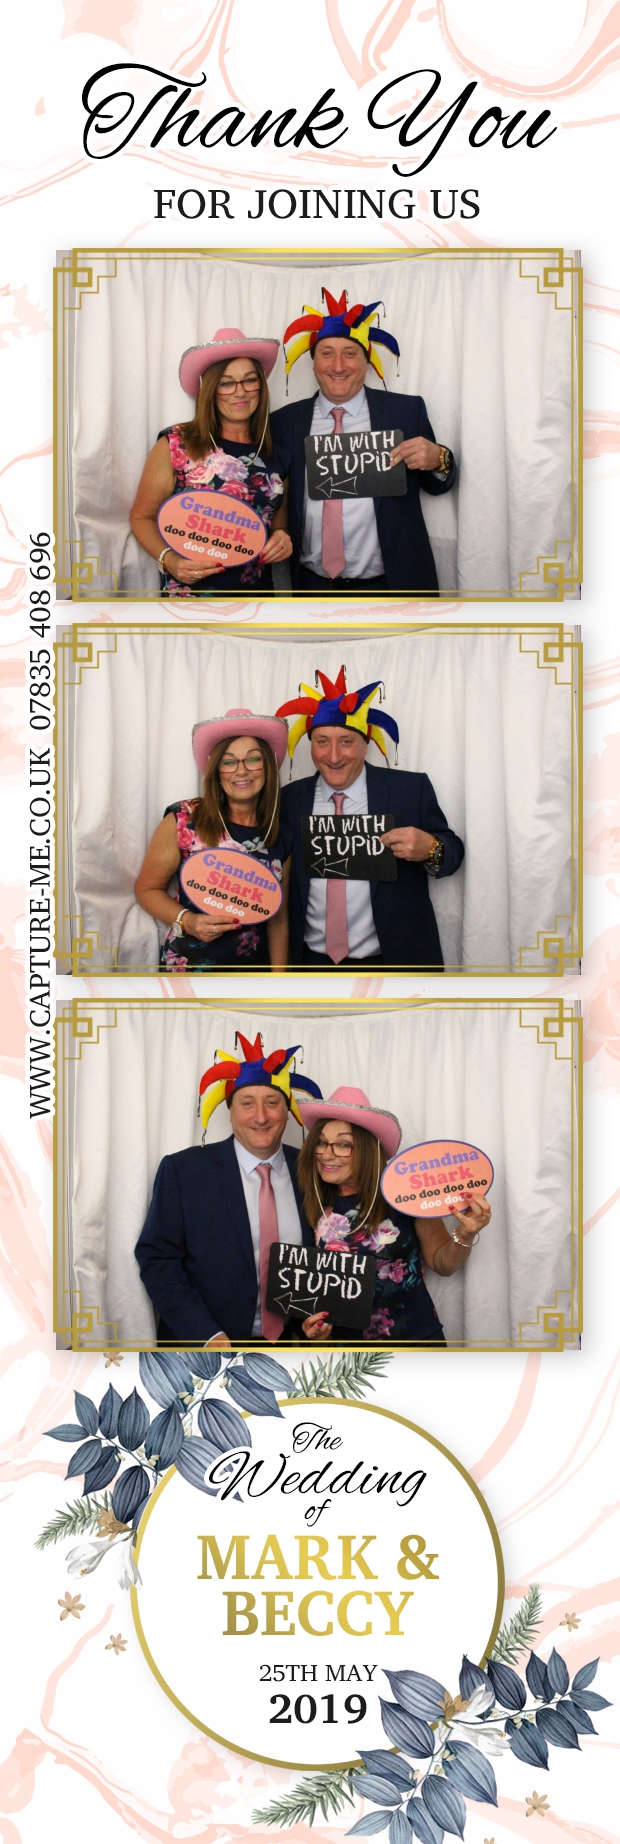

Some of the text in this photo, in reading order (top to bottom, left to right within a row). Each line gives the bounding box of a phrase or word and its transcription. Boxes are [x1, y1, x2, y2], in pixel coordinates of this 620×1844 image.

[314, 434, 343, 454] I'M
[180, 496, 260, 531] Grandma
[164, 525, 254, 556] doo doo doo doo
[185, 514, 247, 543] Shark
[183, 541, 228, 559] doo doo
[309, 816, 336, 834] I'M
[203, 853, 278, 892] Grandma
[186, 879, 270, 916] doo doo doo doo
[206, 870, 264, 904] Shark
[203, 896, 245, 917] doo doo
[393, 1150, 480, 1176] Grandma
[409, 1165, 475, 1190] Shark
[394, 1178, 488, 1204] doo doo doo doo
[420, 1199, 443, 1210] doo
[279, 1243, 308, 1267] I'M
